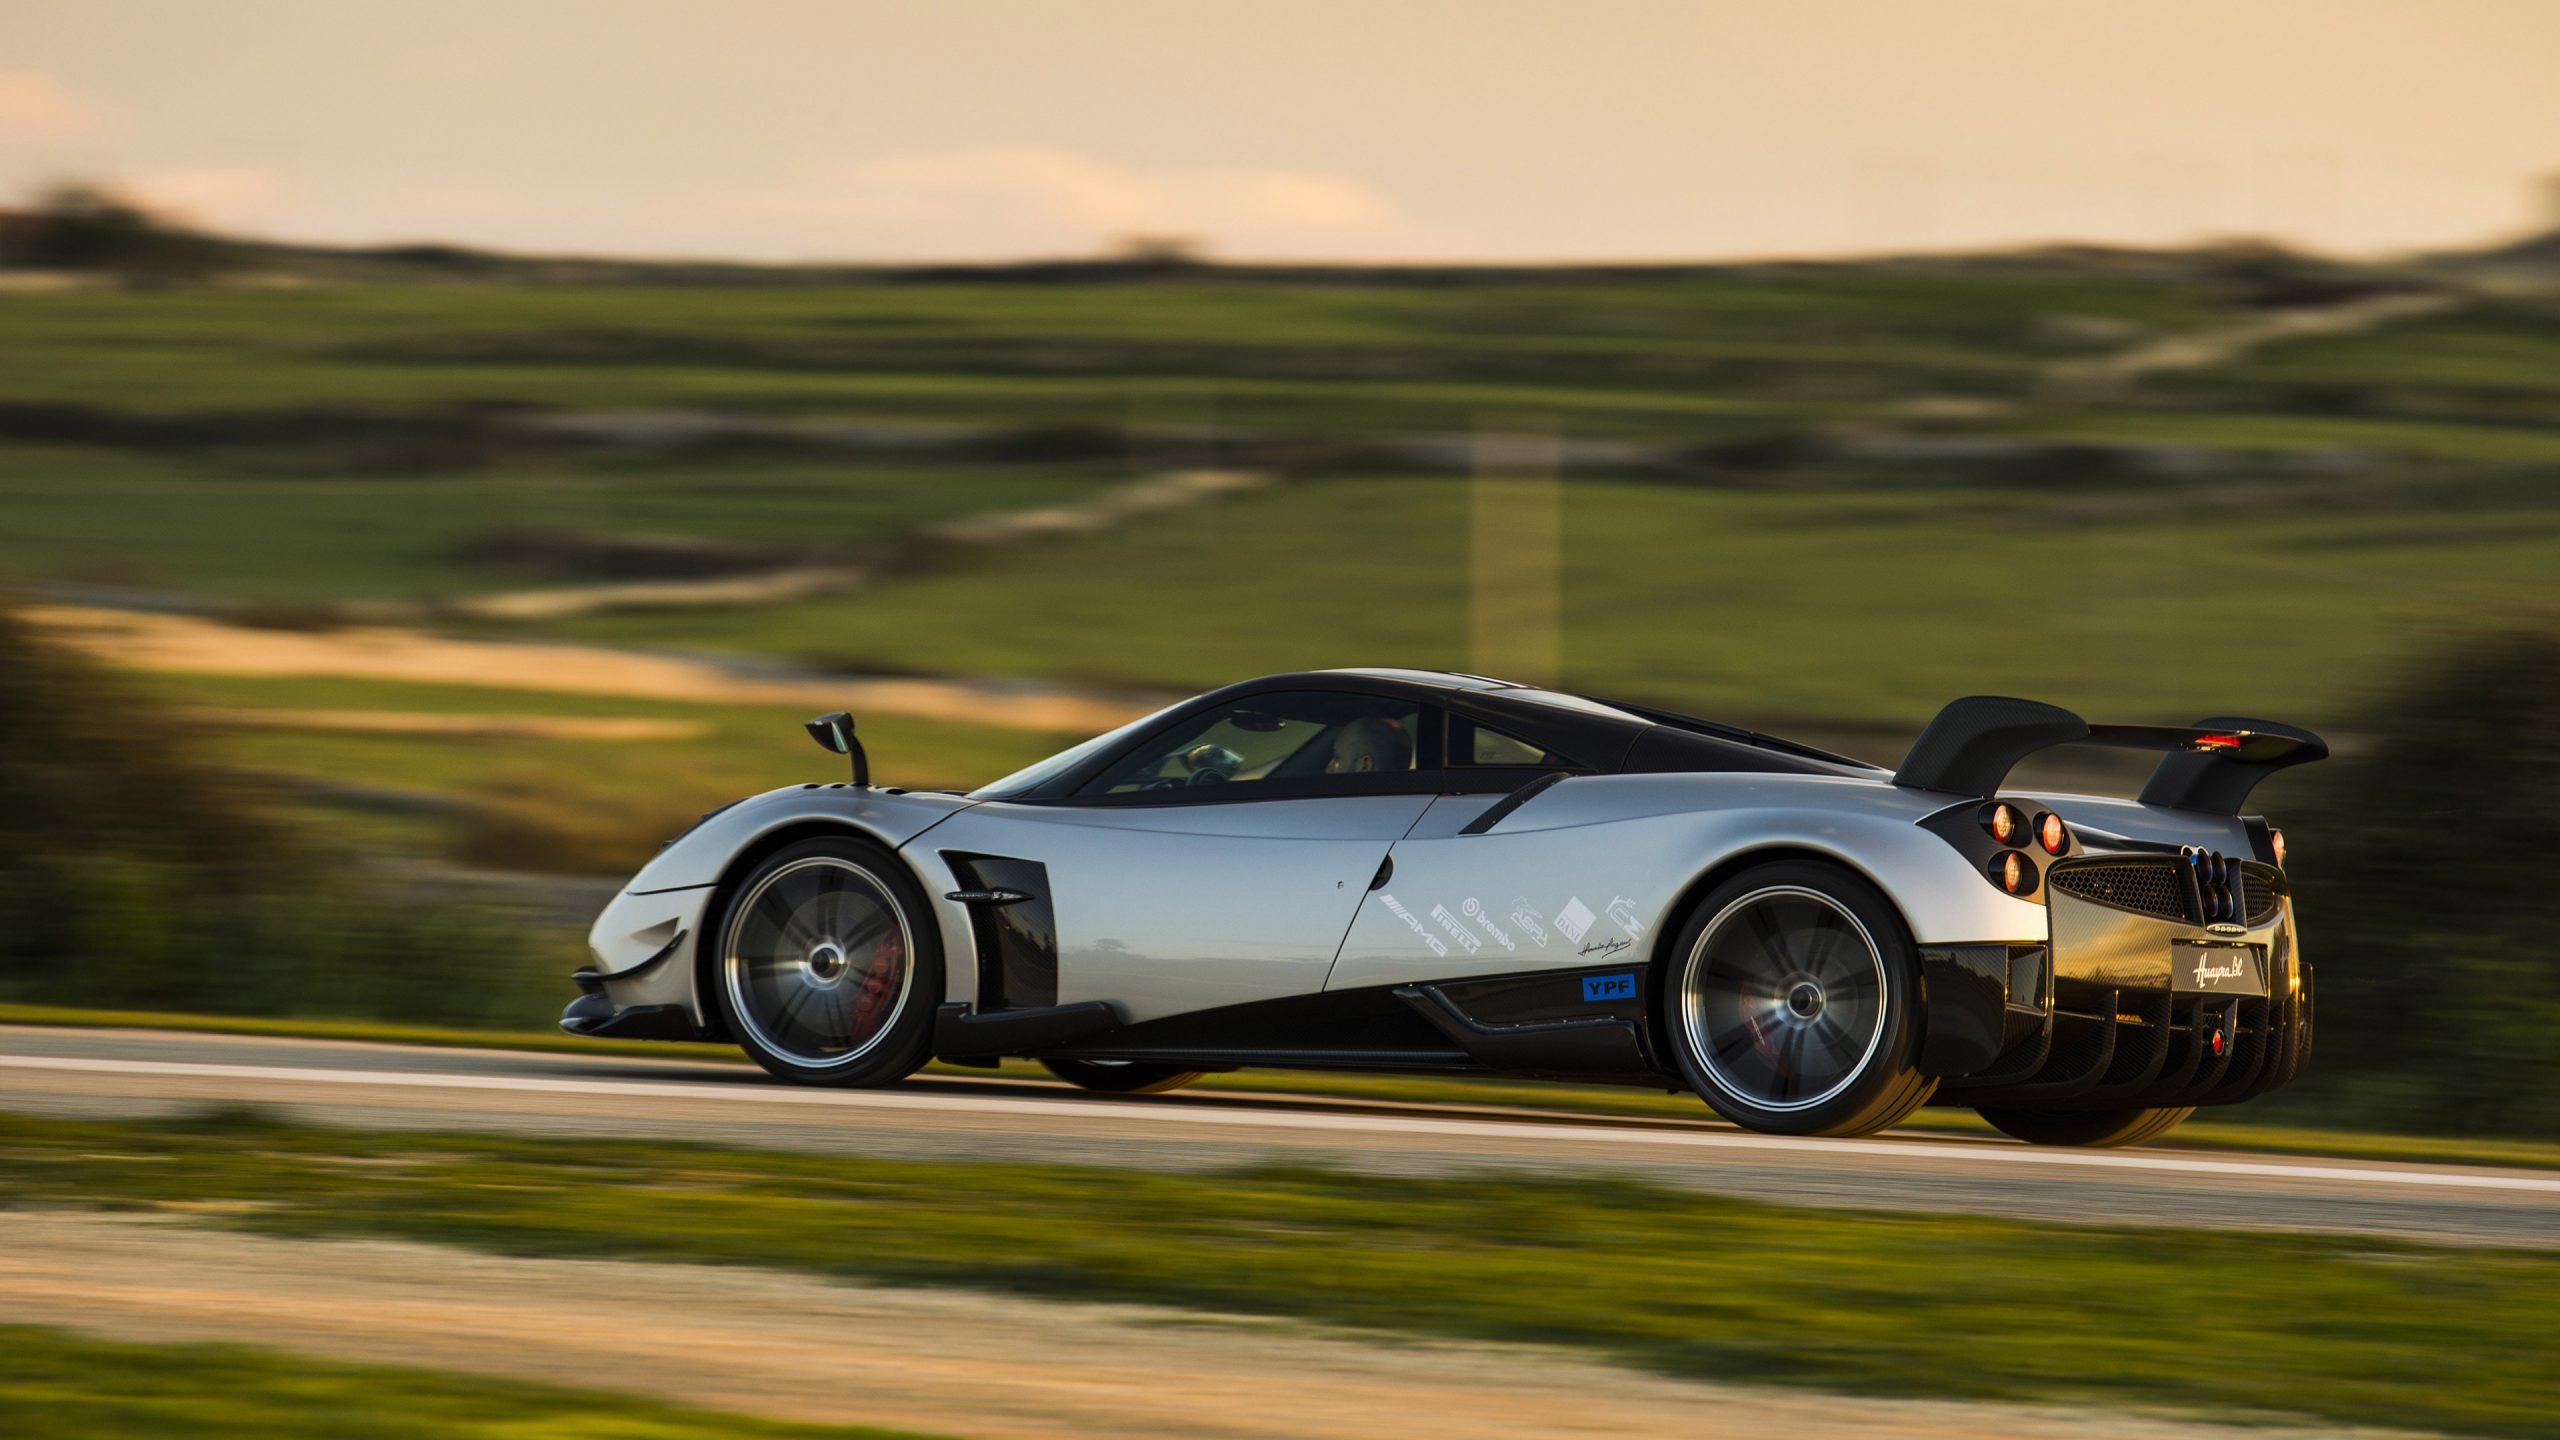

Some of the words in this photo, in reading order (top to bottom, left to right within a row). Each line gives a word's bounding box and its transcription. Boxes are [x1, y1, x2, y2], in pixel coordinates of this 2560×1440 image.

[1429, 903, 1482, 954] PIRELLI
[1476, 911, 1516, 952] brembo
[1555, 918, 1580, 942] DANI
[1587, 980, 1631, 996] YPF
[2192, 952, 2231, 989] Huayra
